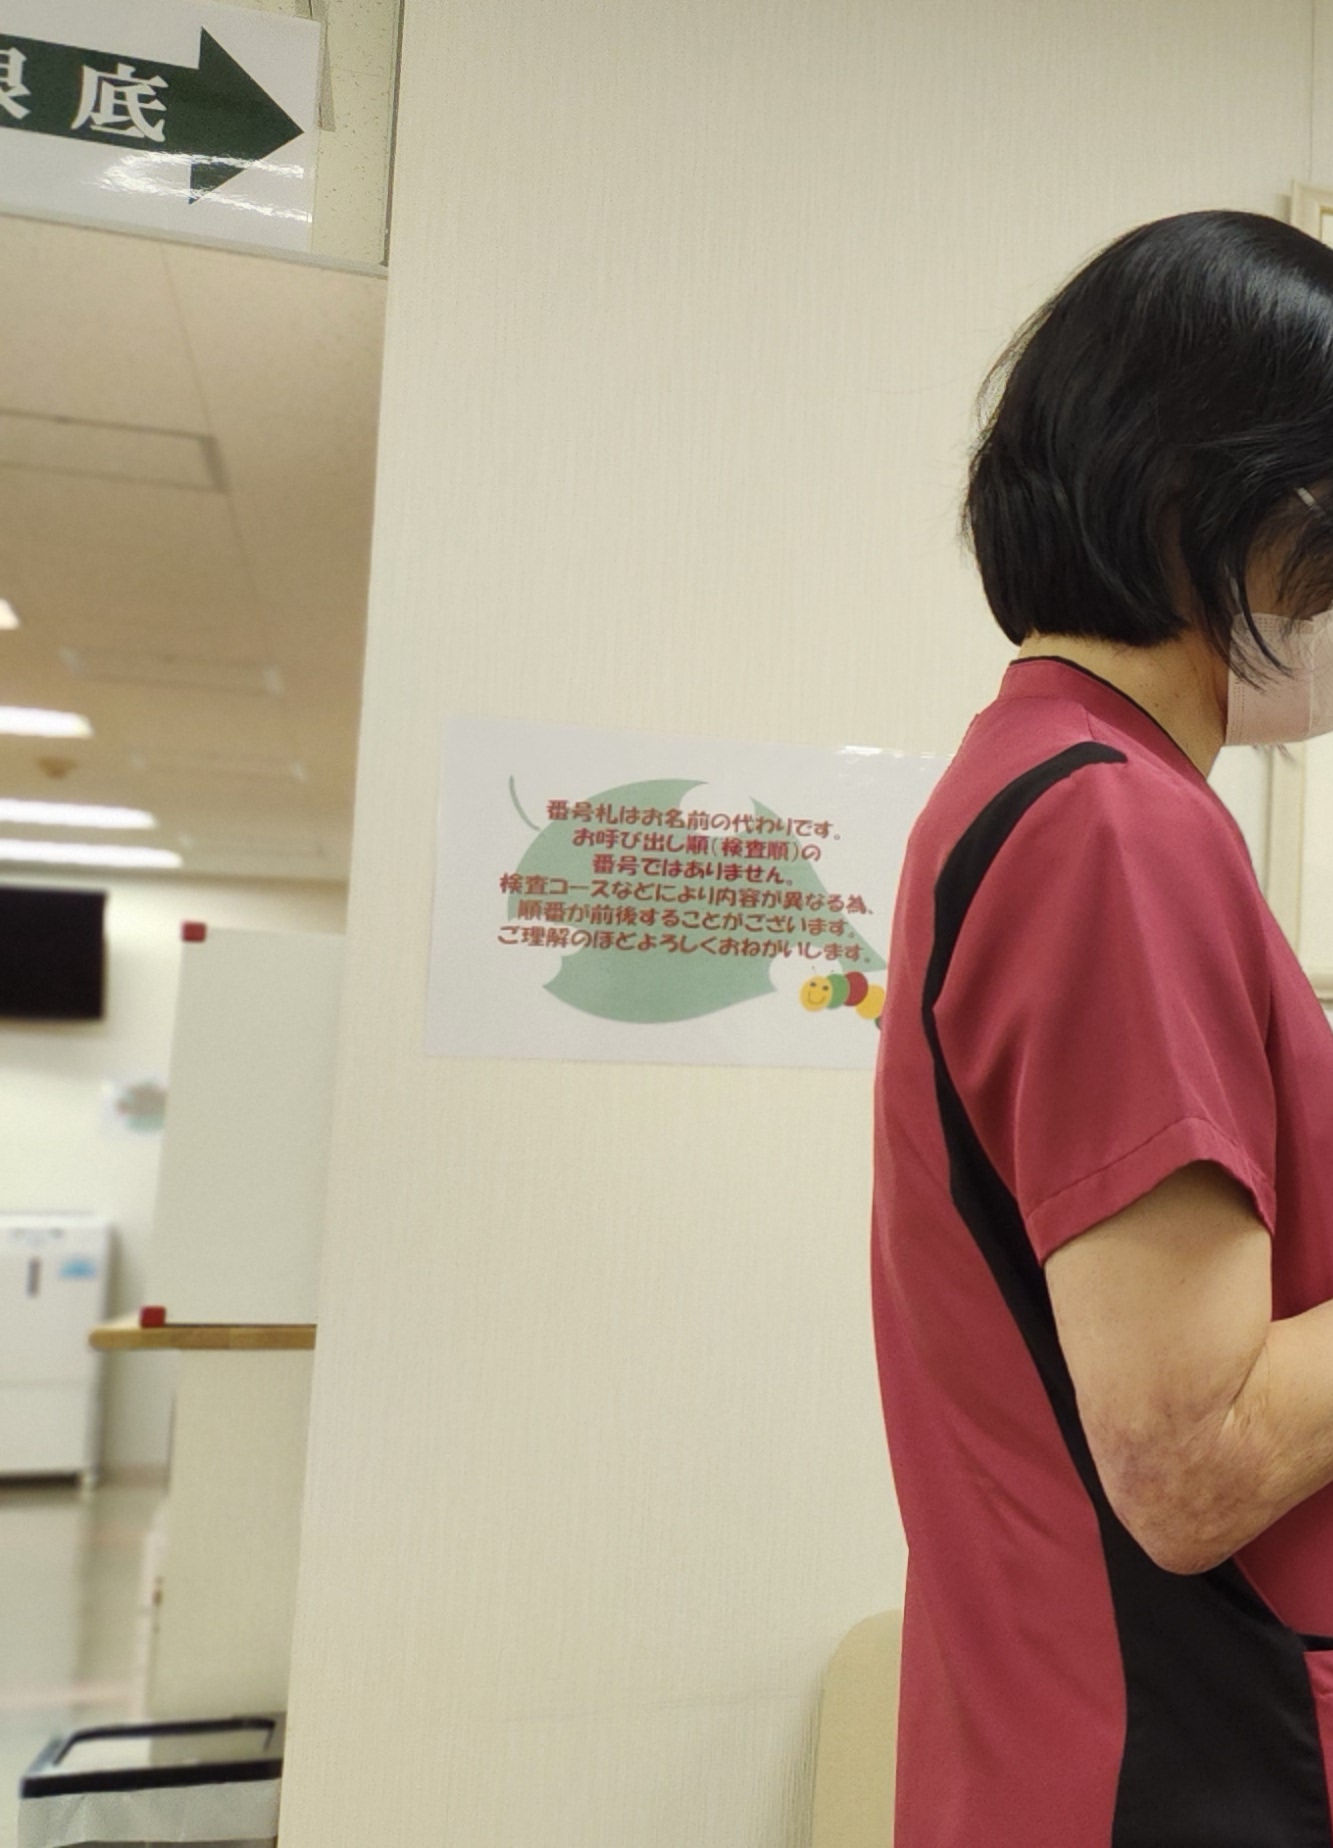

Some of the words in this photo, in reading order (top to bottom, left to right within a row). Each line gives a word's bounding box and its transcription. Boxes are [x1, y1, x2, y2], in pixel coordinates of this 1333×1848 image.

[546, 799, 841, 841] 番号札はお名前の代わりです。
[592, 853, 793, 886] 番号ではありません。
[499, 873, 874, 915] 検査コースなどにより内容が異なる為、
[517, 899, 855, 938] 順番が前後することがございます。
[497, 926, 871, 963] ご理解のほどよろしくおねがいします。
